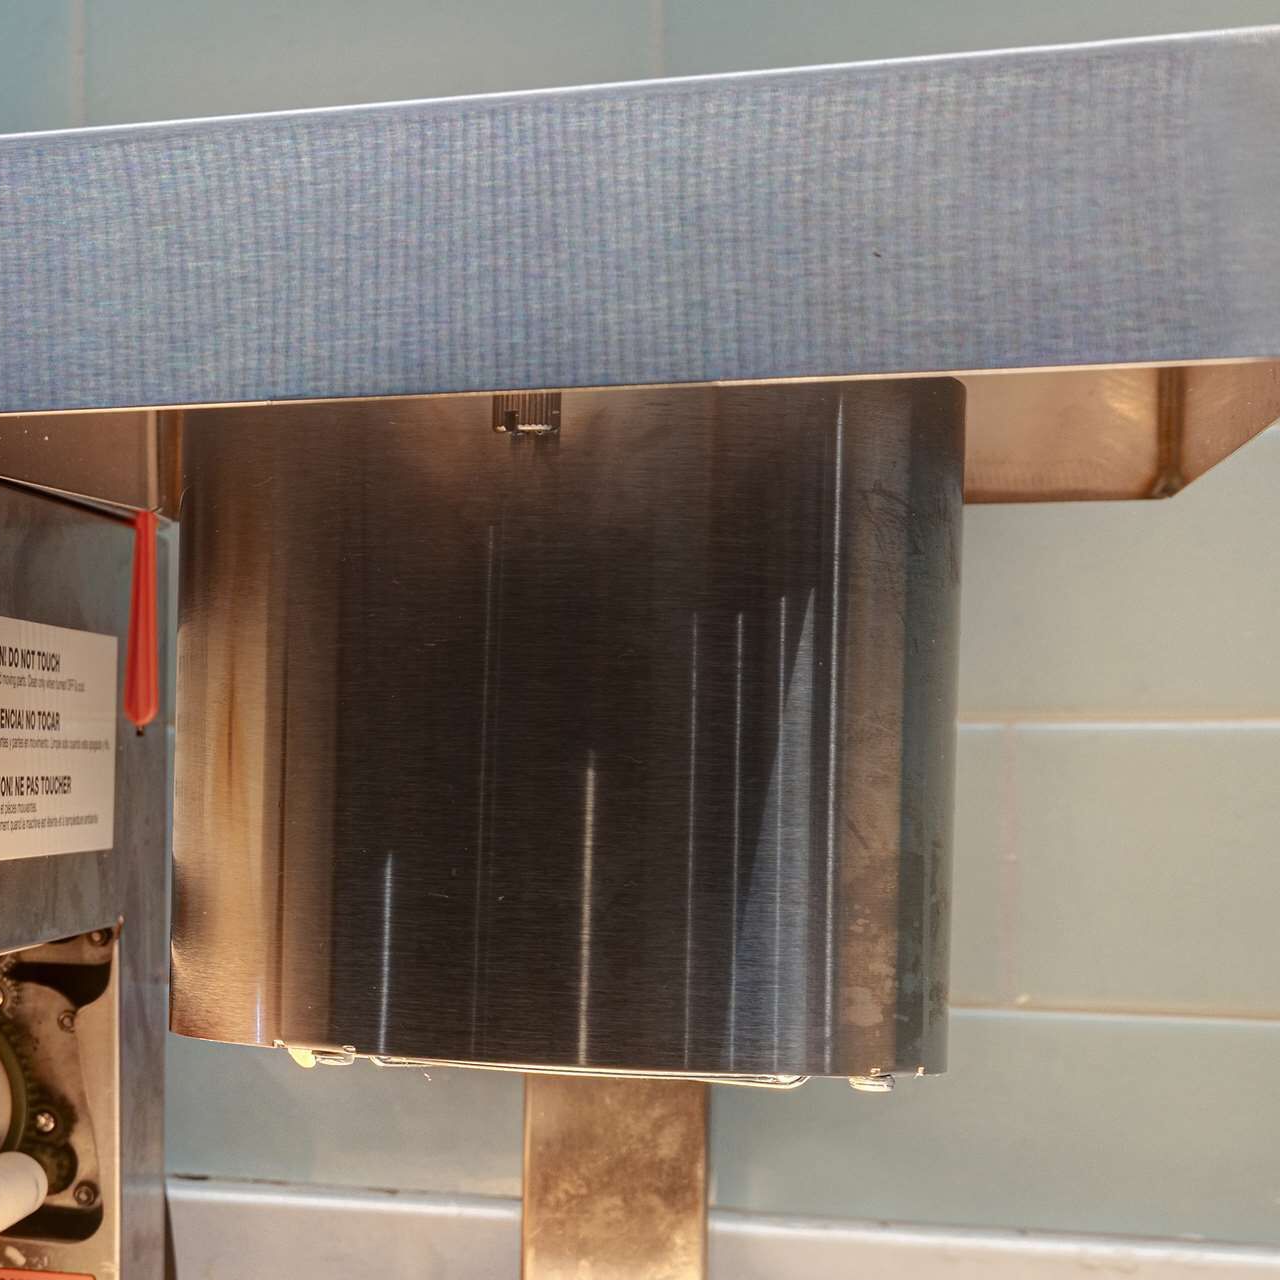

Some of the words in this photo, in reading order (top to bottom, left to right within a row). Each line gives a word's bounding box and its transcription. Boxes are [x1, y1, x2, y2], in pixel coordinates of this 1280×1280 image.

[8, 647, 19, 668] DO
[21, 649, 36, 670] NOT
[37, 651, 60, 672] TOUCH
[25, 710, 36, 730] NO
[37, 711, 60, 731] TOCAR
[15, 776, 24, 796] NE
[26, 776, 39, 796] PAS
[41, 775, 72, 795] TOUCHER
